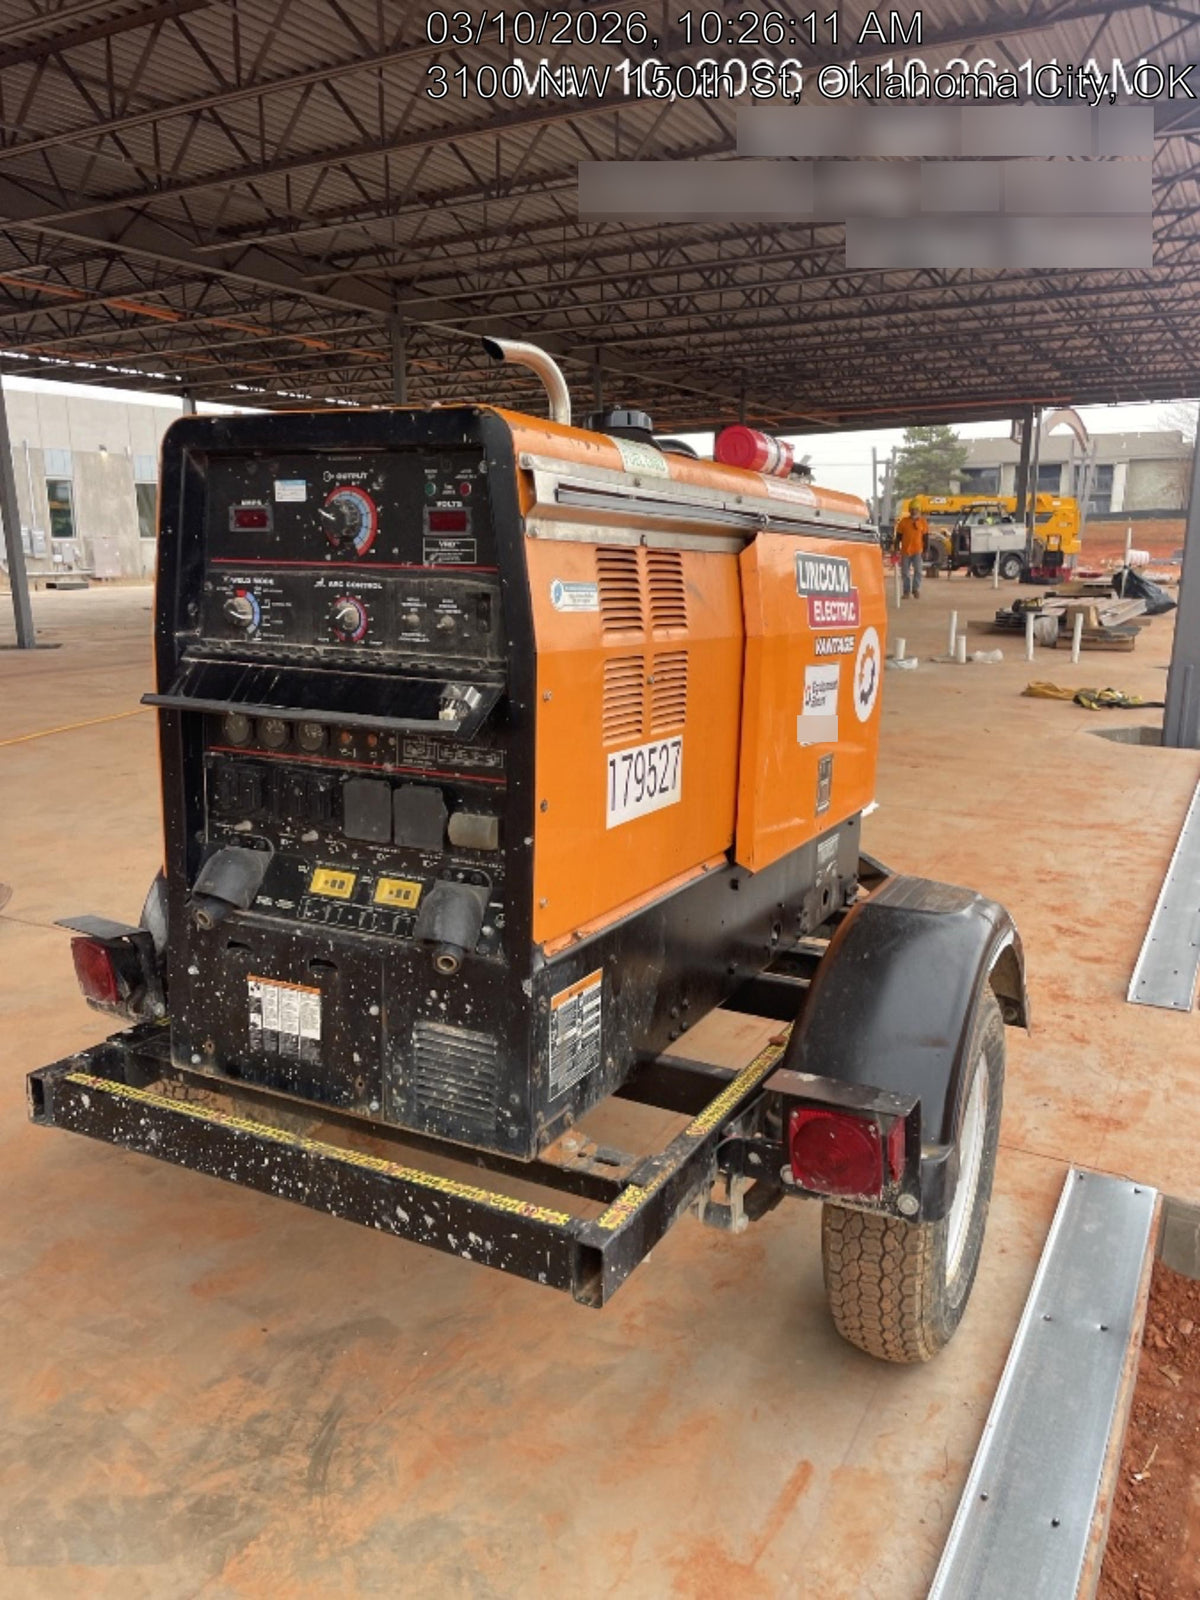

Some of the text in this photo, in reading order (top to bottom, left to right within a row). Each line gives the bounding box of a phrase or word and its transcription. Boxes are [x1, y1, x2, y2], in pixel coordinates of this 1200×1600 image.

[797, 559, 850, 594] LINCOLN
[813, 599, 857, 623] ELECTRIC
[608, 739, 682, 812] 179527
